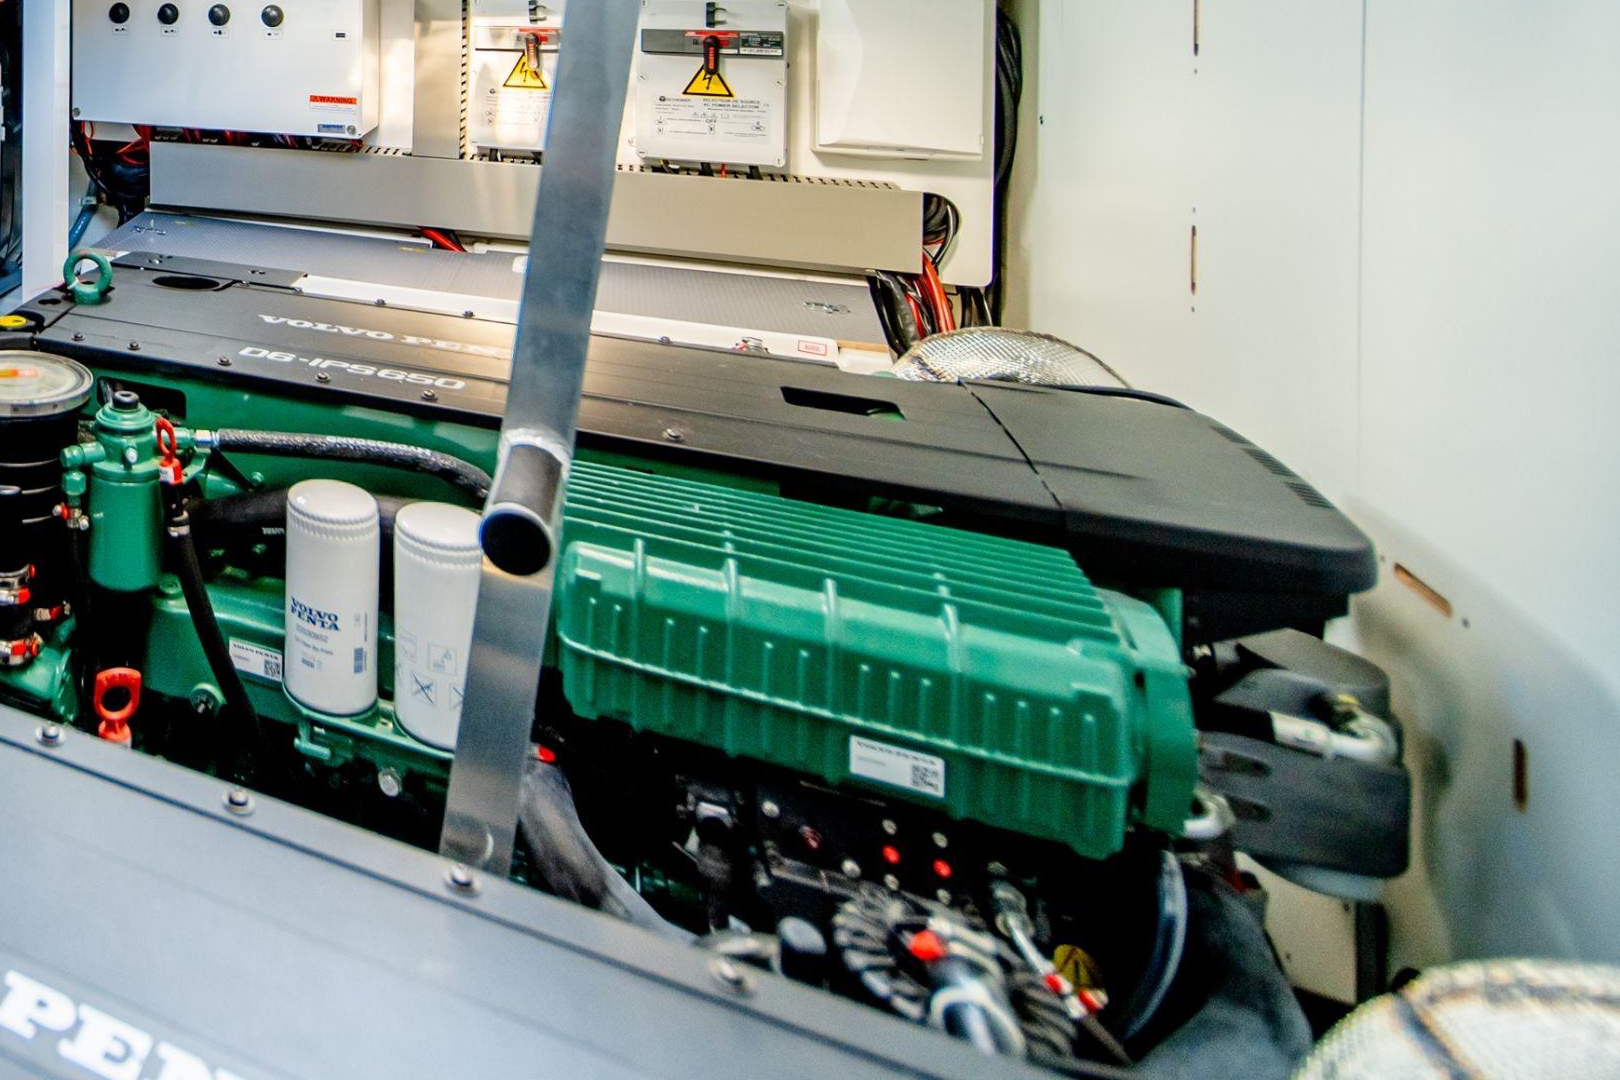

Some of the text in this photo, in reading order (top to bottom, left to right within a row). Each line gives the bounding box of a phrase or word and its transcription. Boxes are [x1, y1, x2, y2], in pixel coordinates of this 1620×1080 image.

[318, 95, 353, 104] WARNING
[258, 314, 394, 340] VOLVO
[238, 346, 466, 391] D6-IPS650
[290, 604, 340, 632] PENTA
[291, 596, 339, 622] VOLVO
